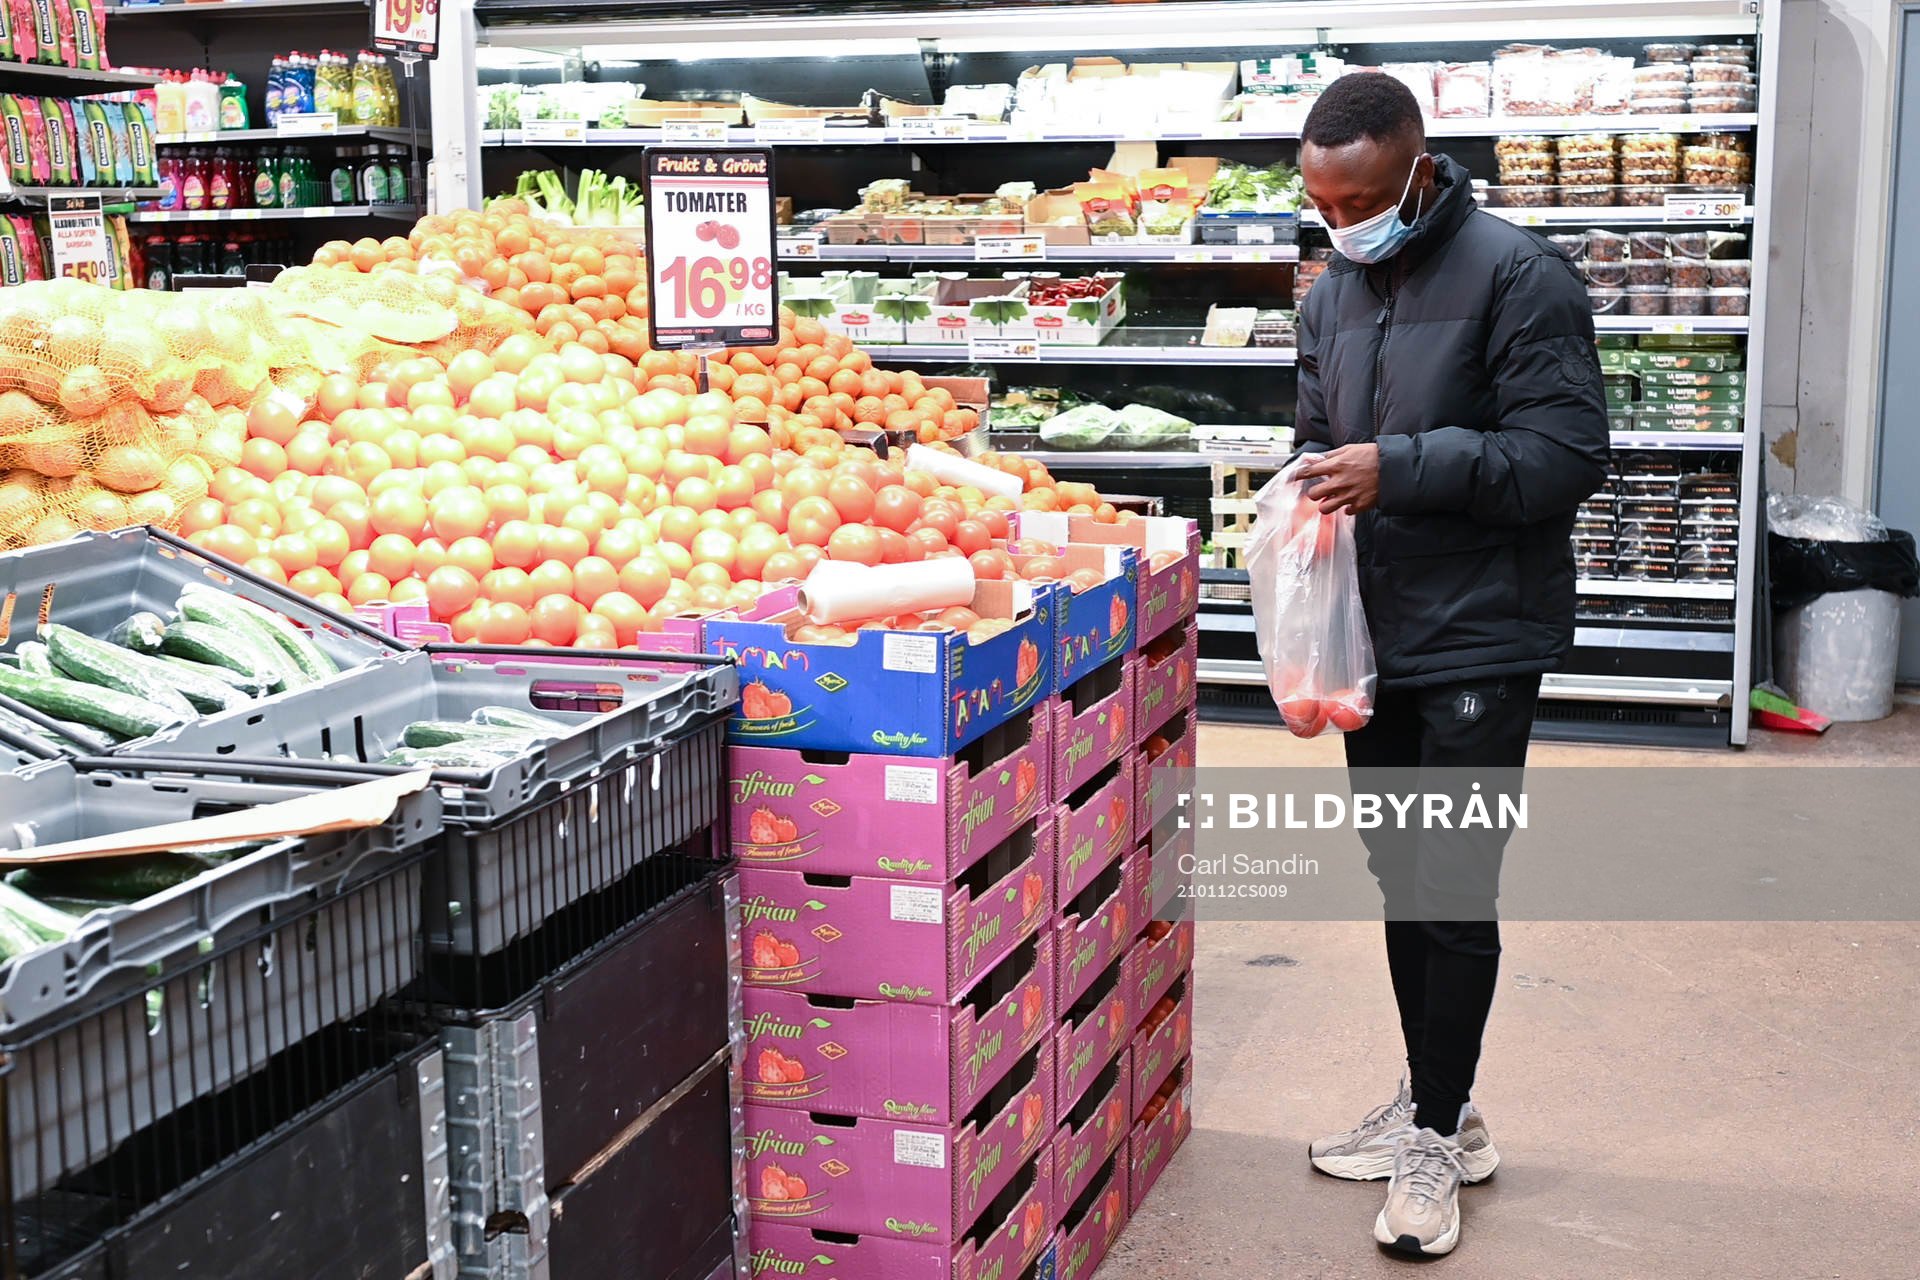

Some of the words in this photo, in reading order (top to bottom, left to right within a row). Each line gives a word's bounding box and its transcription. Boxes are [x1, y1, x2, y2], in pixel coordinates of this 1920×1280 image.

[657, 157, 700, 173] Frukt
[704, 156, 718, 173] &
[722, 157, 767, 174] Grönt
[664, 191, 748, 213] TOMATER
